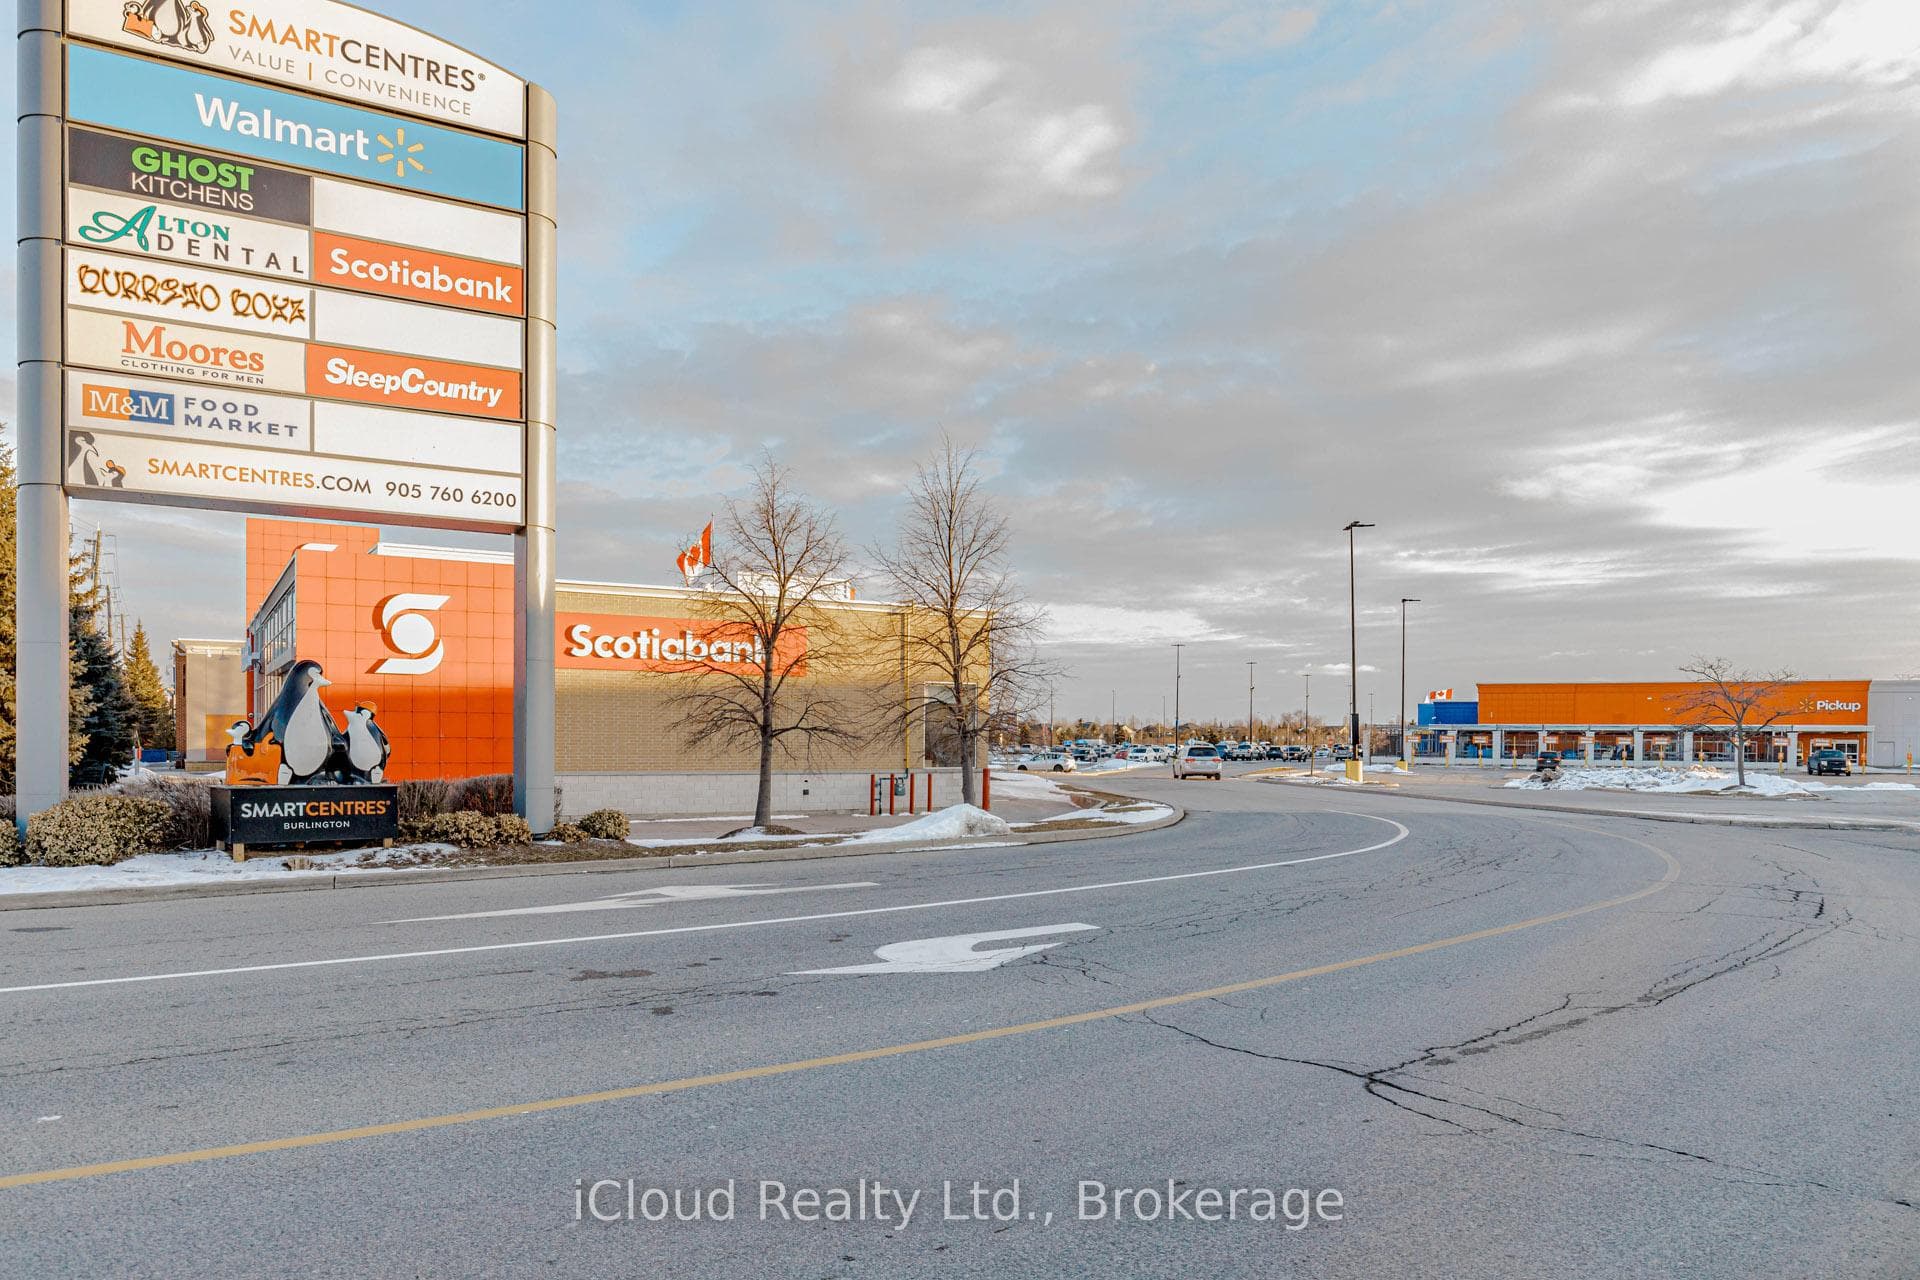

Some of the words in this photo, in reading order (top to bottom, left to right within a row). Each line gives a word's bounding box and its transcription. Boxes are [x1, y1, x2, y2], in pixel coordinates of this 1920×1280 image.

[228, 45, 295, 74] VALUE
[325, 69, 471, 116] CONVENIENCE
[195, 94, 369, 161] Walmart
[131, 146, 254, 191] GHOST
[130, 172, 254, 211] KITCHENS
[78, 205, 230, 251] ALTON
[157, 234, 304, 273] DENTAL
[330, 248, 512, 303] Scotiabank
[78, 264, 221, 312] BURRITO
[231, 288, 306, 324] BOYZ
[121, 320, 264, 372] Moores
[121, 359, 195, 375] CLOTHING
[202, 370, 229, 380] FOR
[235, 375, 264, 384] MEN
[324, 357, 503, 407] SleepCountry
[89, 390, 169, 420] M&M
[184, 397, 259, 416] FOOD
[184, 414, 298, 437] MARKET
[148, 458, 372, 494] SMARTCENTRES.COM
[386, 481, 422, 498] 905
[430, 486, 464, 502] 760
[471, 490, 516, 508] 6200
[1816, 699, 1861, 713] Pickup
[283, 820, 350, 830] BURLINGTON
